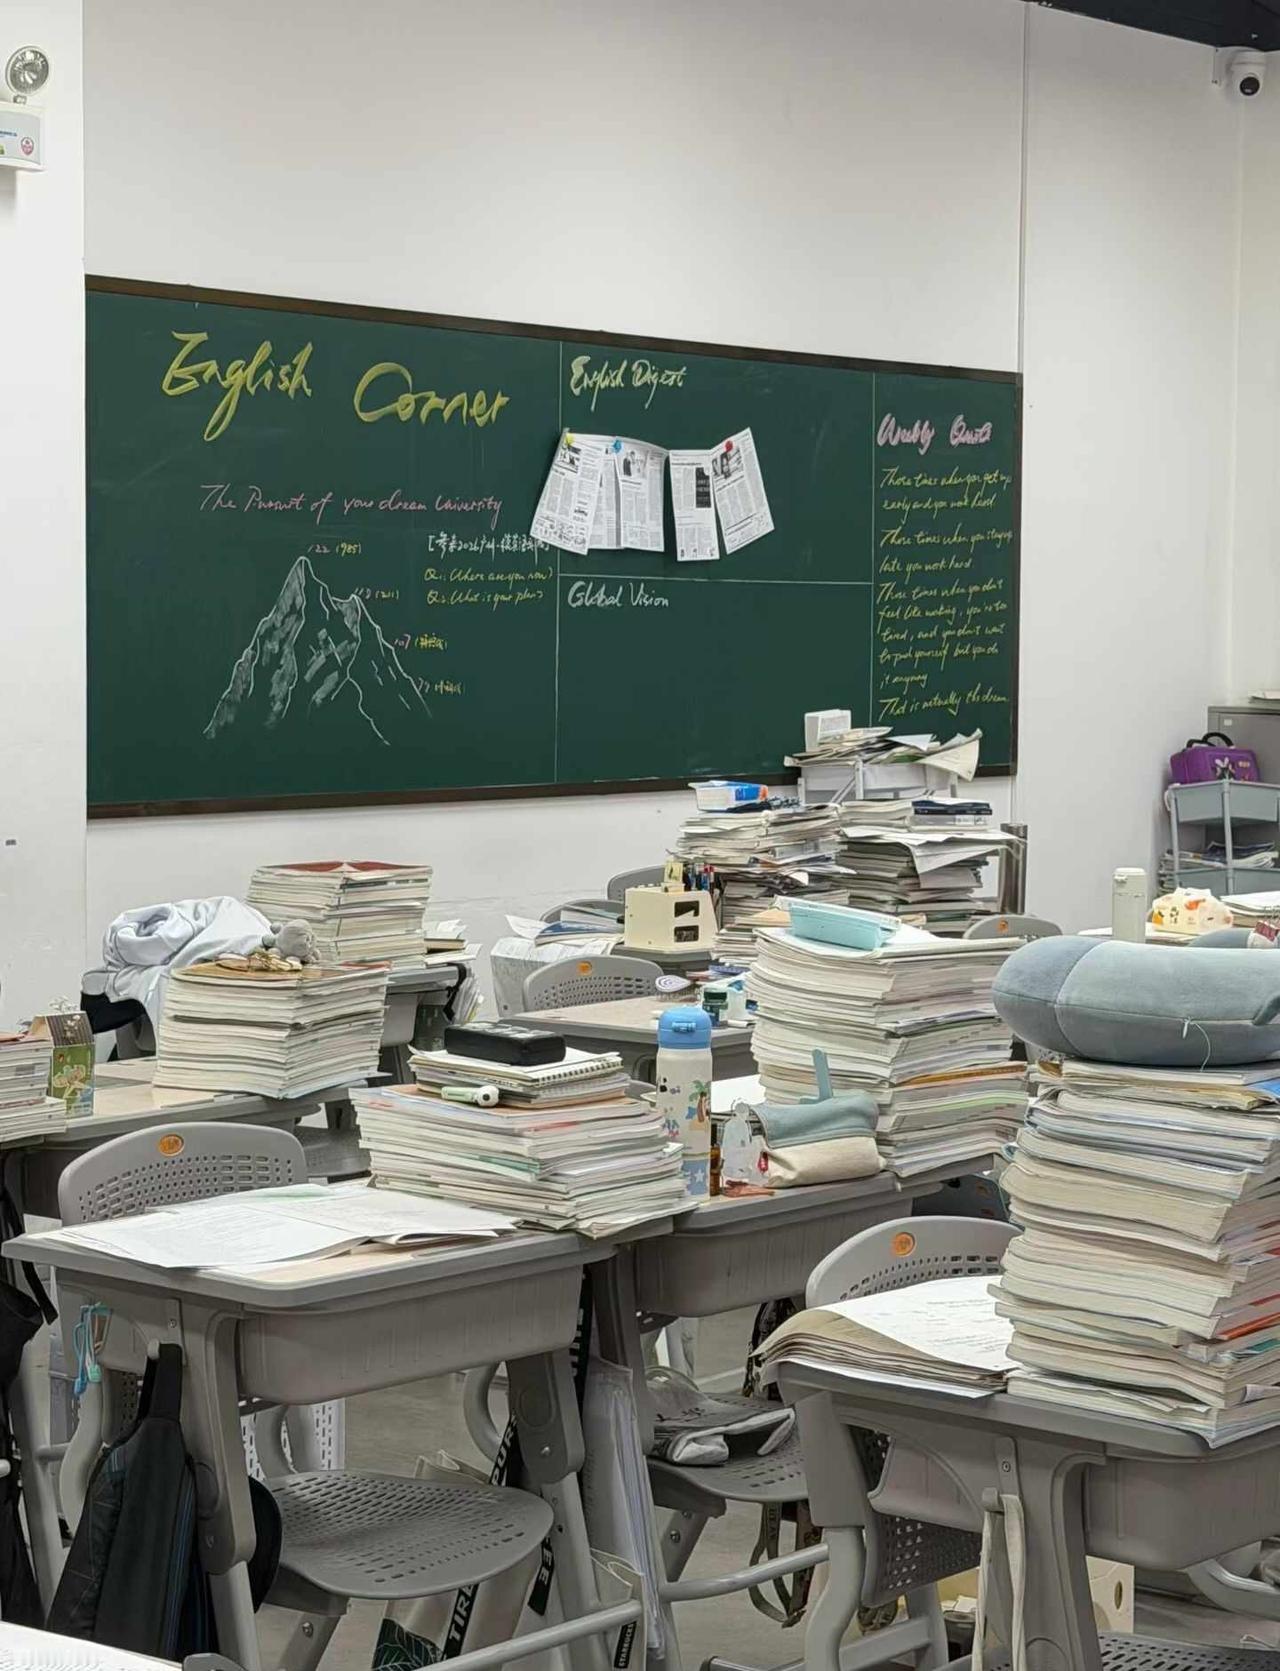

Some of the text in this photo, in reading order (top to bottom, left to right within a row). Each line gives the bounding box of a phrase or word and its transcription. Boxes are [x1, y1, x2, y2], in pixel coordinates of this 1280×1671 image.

[161, 331, 510, 442] English Corner
[570, 355, 687, 411] English Digest
[200, 483, 236, 511] The
[310, 491, 333, 525] of
[378, 488, 428, 511] dream
[335, 542, 361, 557] (985)
[880, 526, 912, 548] Those
[450, 567, 484, 582] Where
[567, 580, 669, 608] Global Vision
[876, 581, 907, 605] Those
